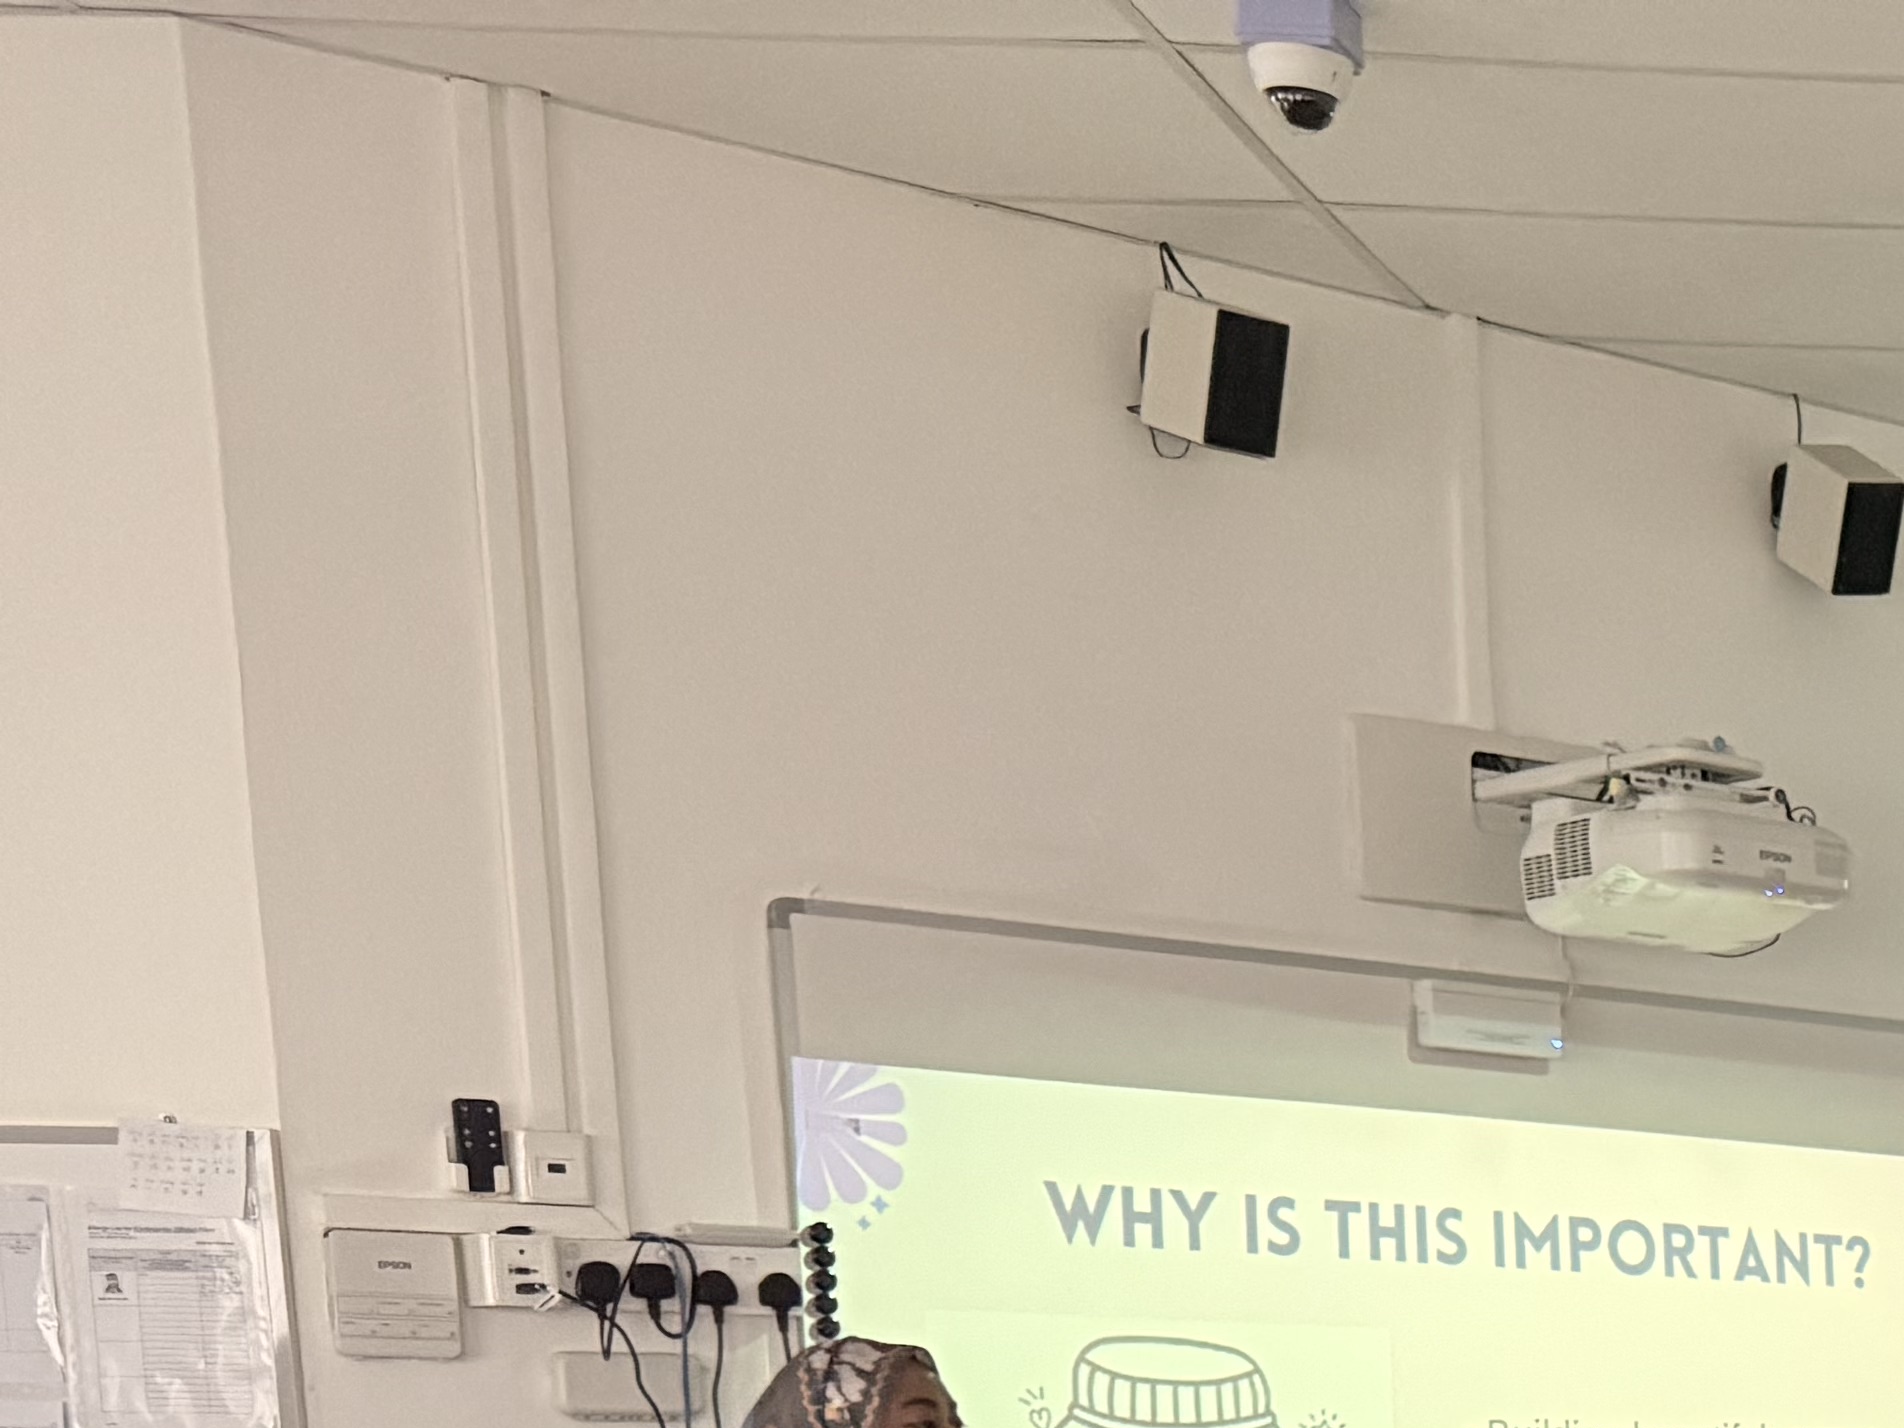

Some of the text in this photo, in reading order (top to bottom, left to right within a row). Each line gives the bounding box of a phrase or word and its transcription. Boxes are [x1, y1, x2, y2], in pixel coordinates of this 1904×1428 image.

[1043, 1180, 1872, 1289] WHY IS THIS IMPORTANT?
